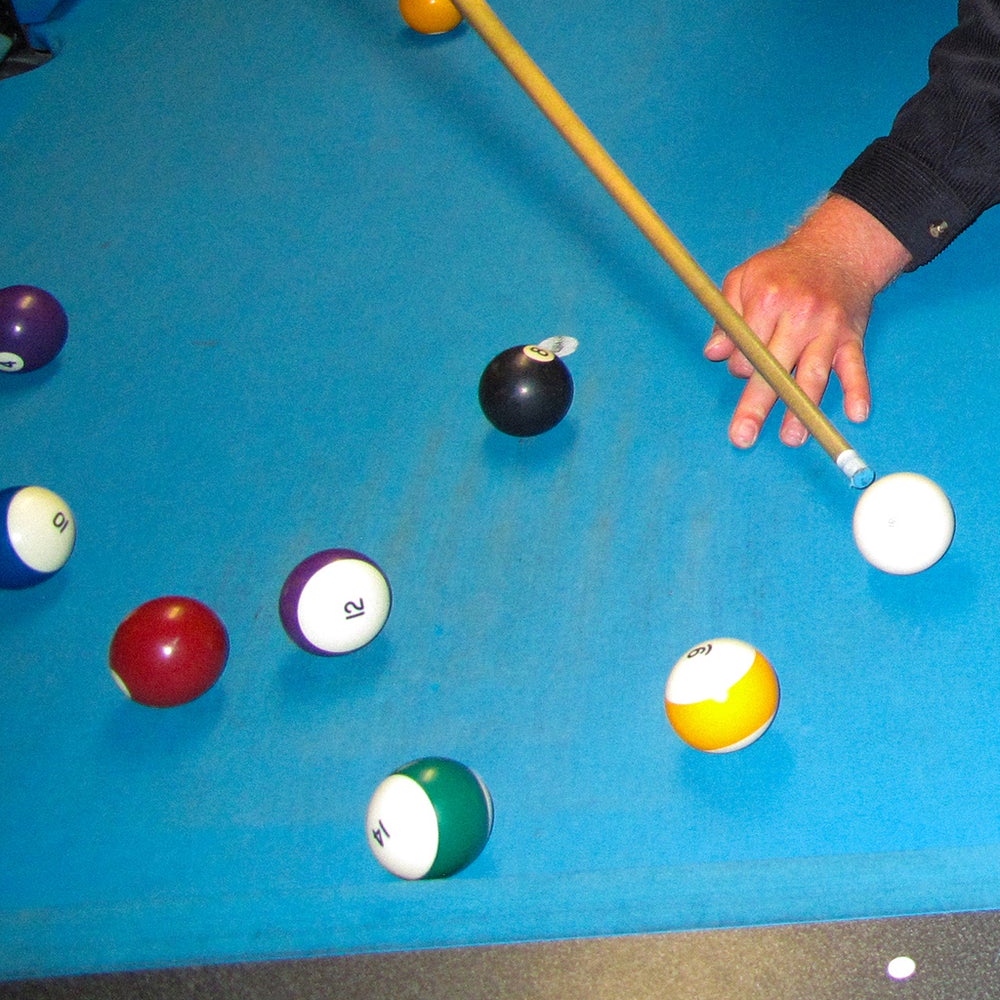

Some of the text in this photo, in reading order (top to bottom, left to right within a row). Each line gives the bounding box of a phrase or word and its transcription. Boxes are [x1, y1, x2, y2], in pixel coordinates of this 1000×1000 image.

[530, 346, 548, 356] 8
[0, 360, 16, 368] 4
[52, 511, 69, 534] 10
[344, 597, 366, 620] 12
[371, 819, 391, 847] 14
